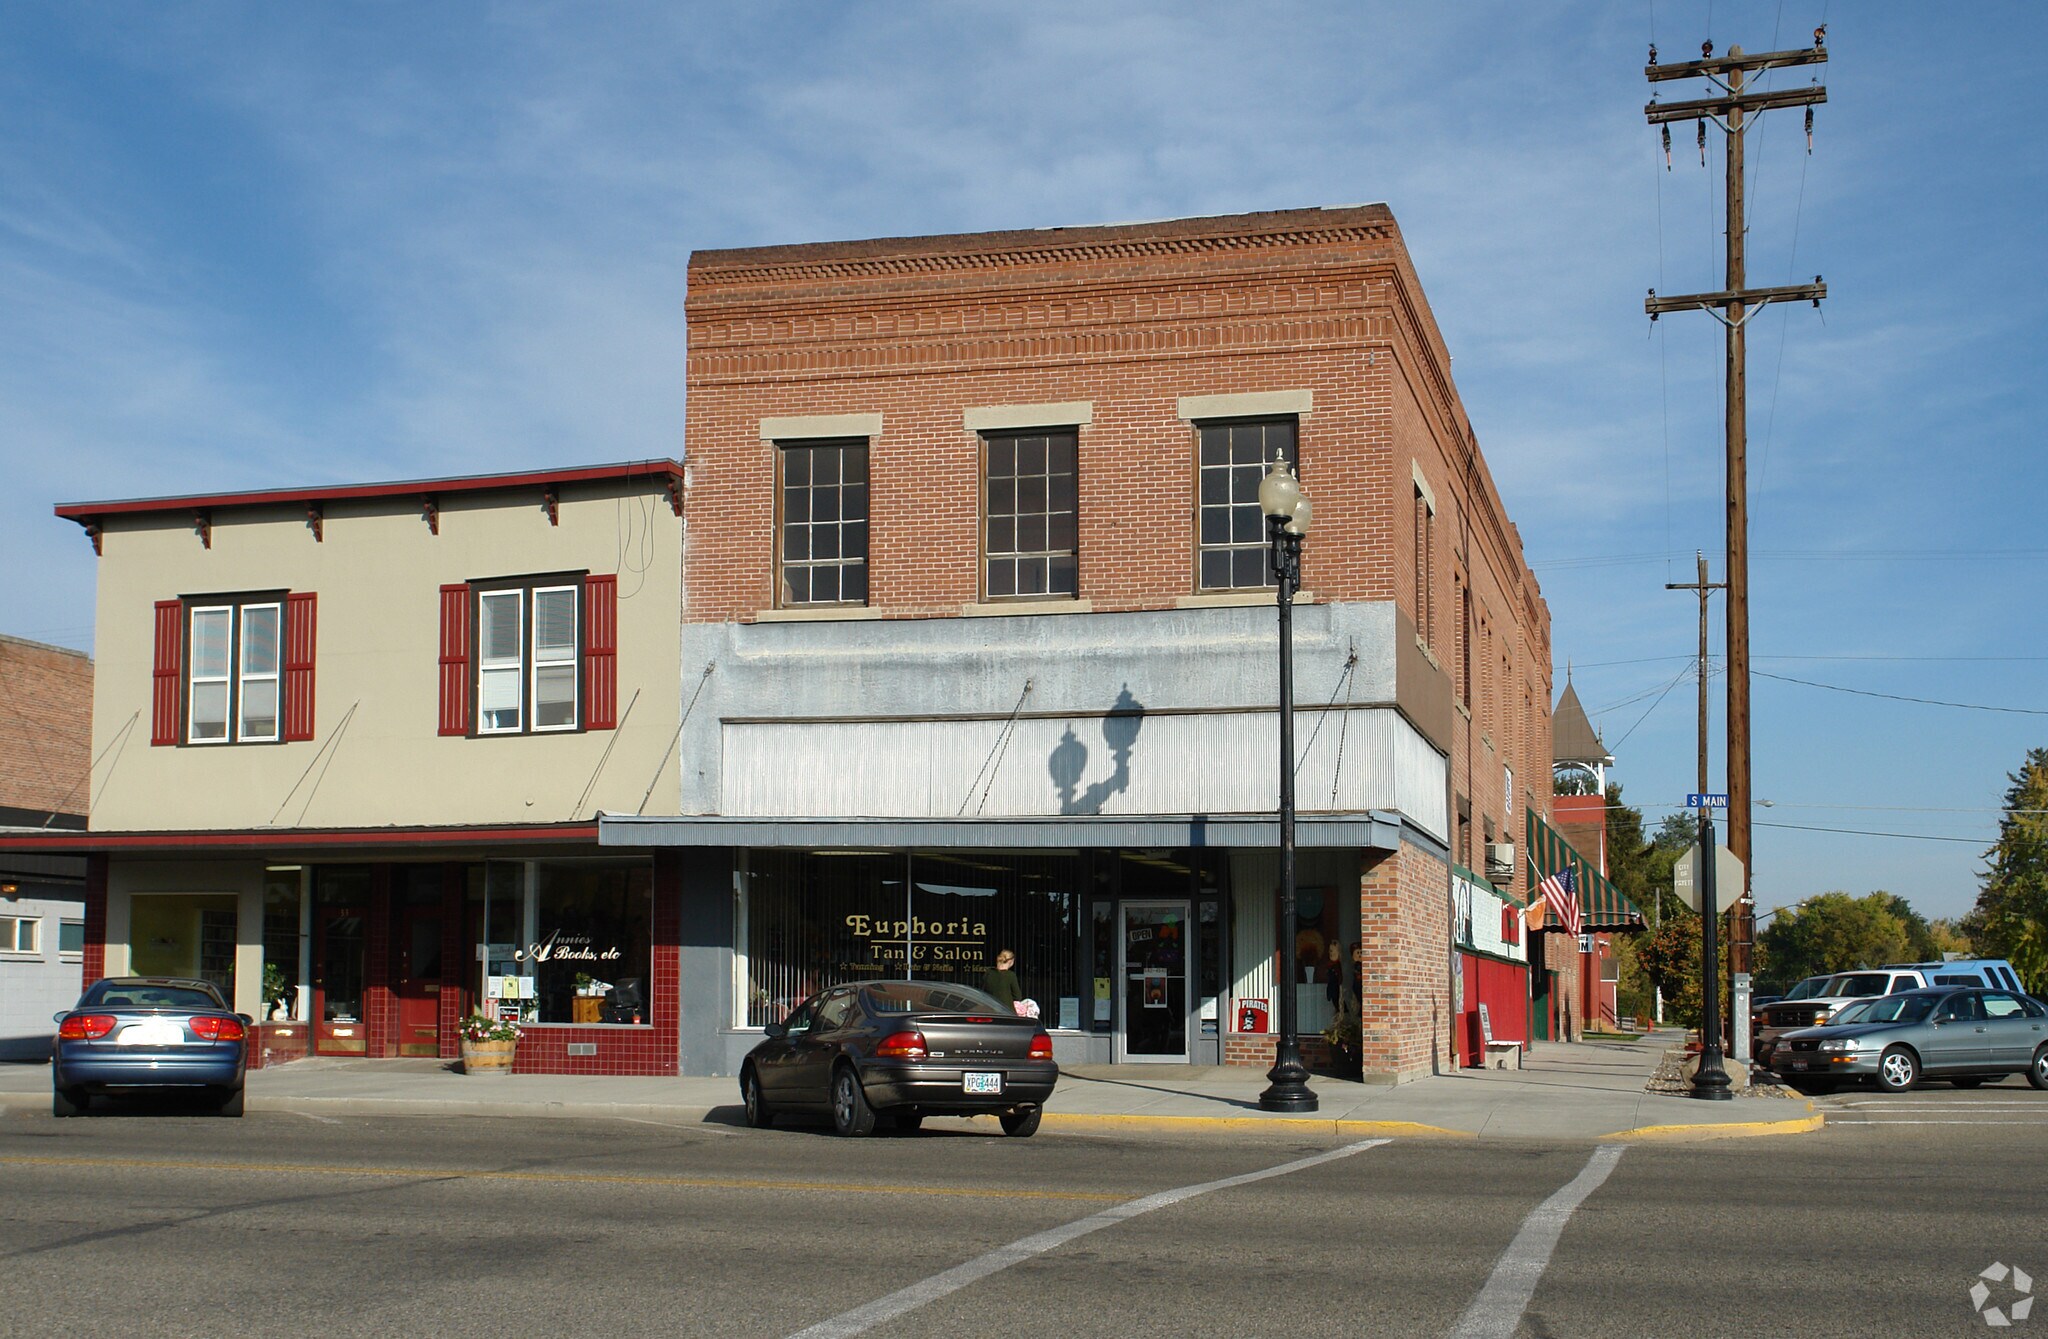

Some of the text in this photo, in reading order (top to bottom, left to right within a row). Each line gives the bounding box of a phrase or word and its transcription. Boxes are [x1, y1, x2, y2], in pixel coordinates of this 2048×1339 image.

[1691, 796, 1726, 806] S MAIN
[1674, 879, 1693, 887] PAYETT
[845, 914, 987, 938] Euphoria
[1132, 929, 1151, 941] OPEN
[870, 945, 984, 961] Tan & Salon
[1242, 1000, 1267, 1013] PIRATES
